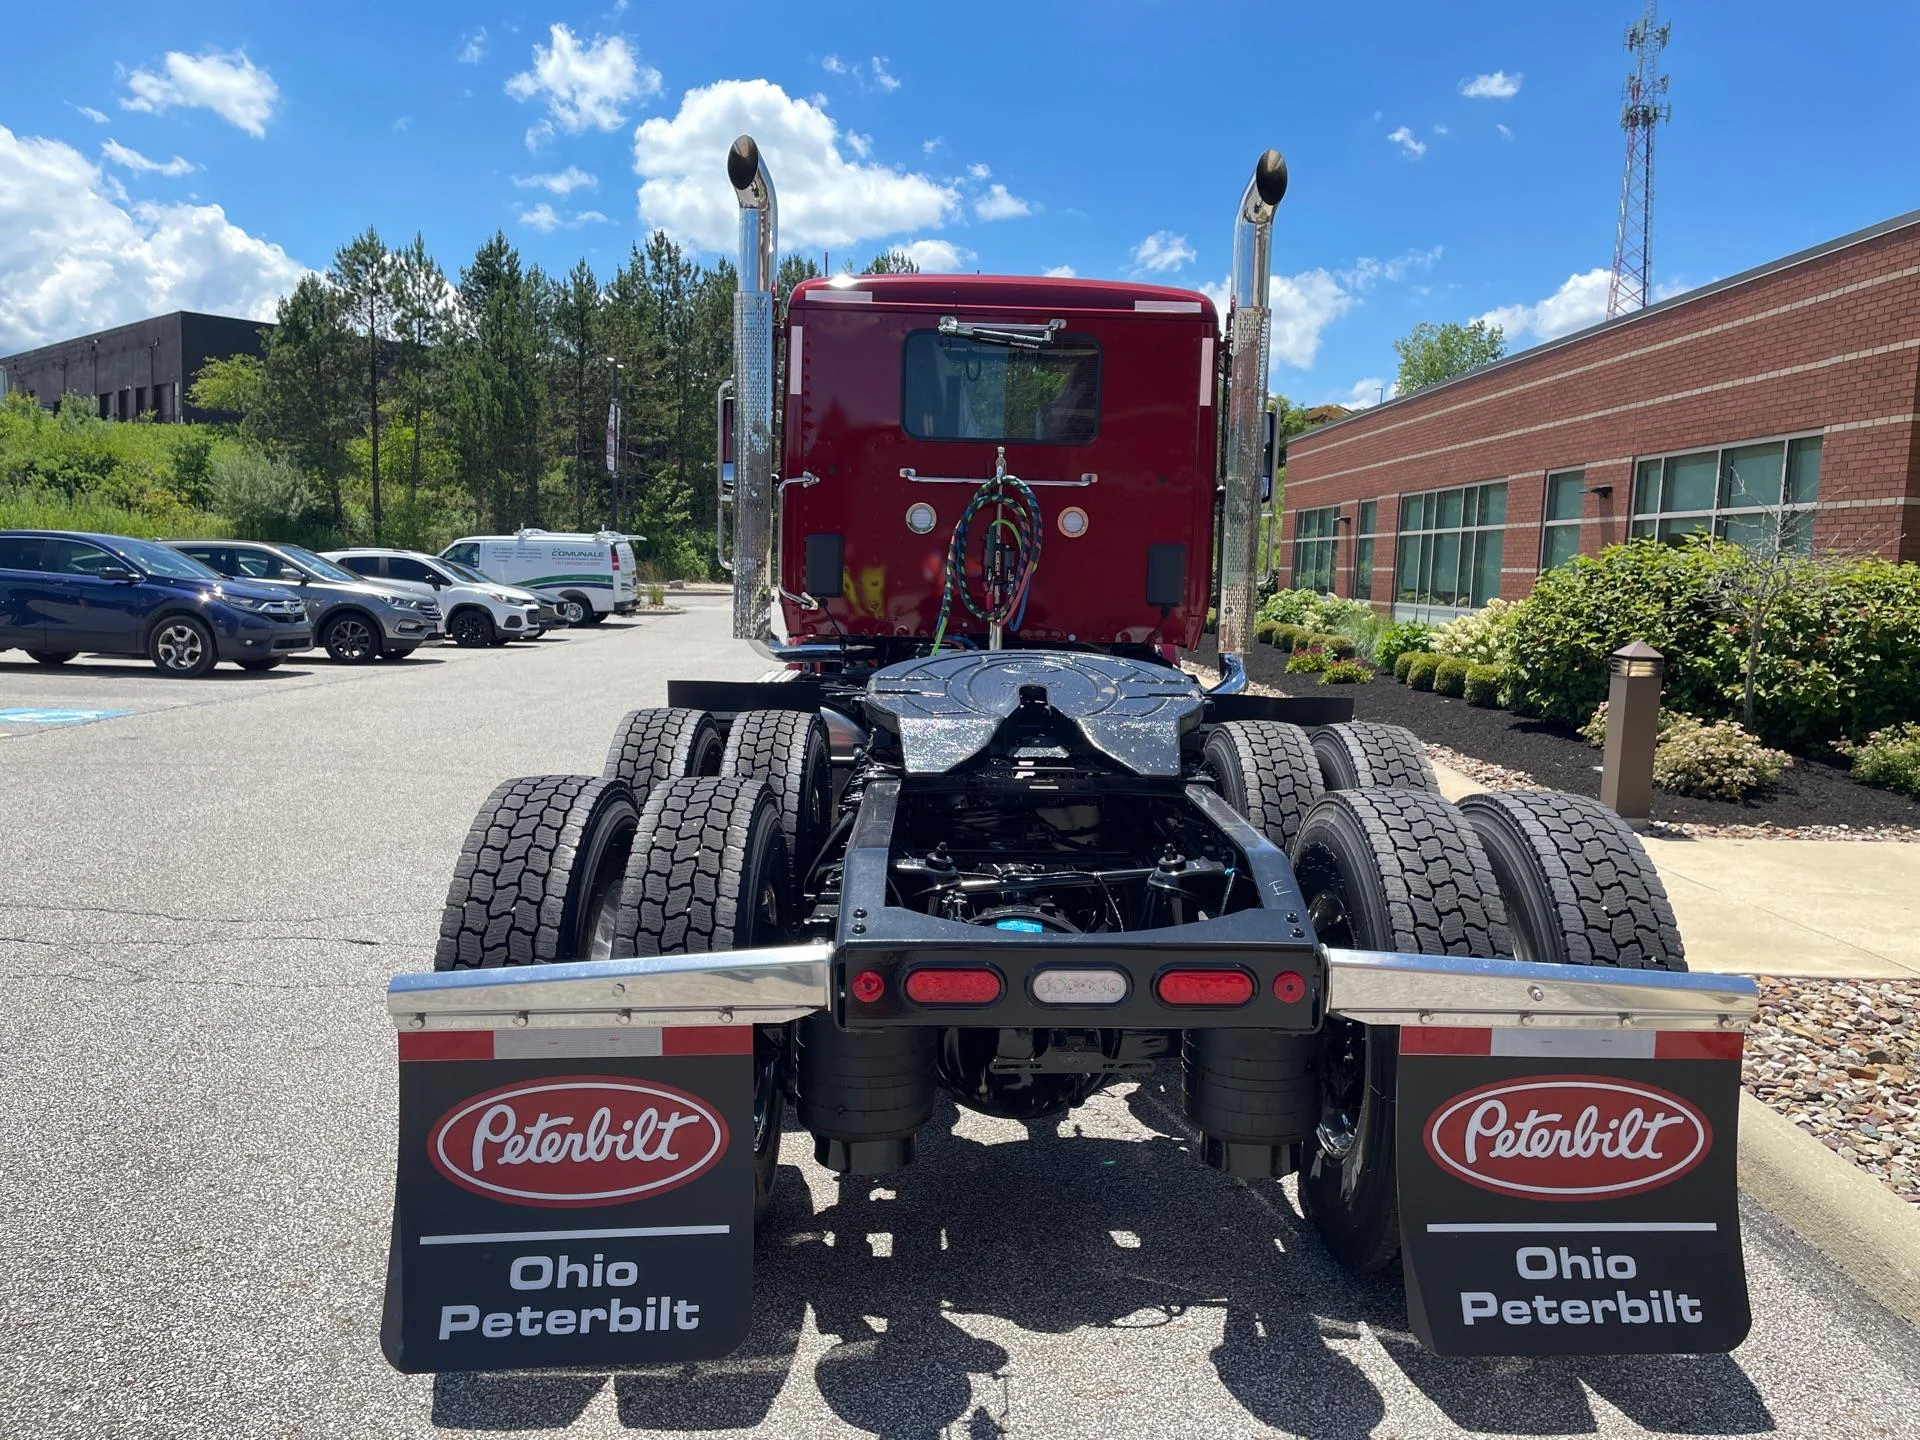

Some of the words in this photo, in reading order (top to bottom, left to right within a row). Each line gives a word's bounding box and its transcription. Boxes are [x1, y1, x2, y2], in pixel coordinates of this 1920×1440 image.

[1268, 880, 1293, 896] E
[472, 1104, 700, 1172] Peterbilt
[1465, 1099, 1684, 1164] Peterbilt
[510, 1253, 638, 1290] Ohio
[1516, 1247, 1637, 1280] Ohio
[439, 1296, 700, 1340] Peterbilt
[1460, 1290, 1702, 1325] Peterbilt
